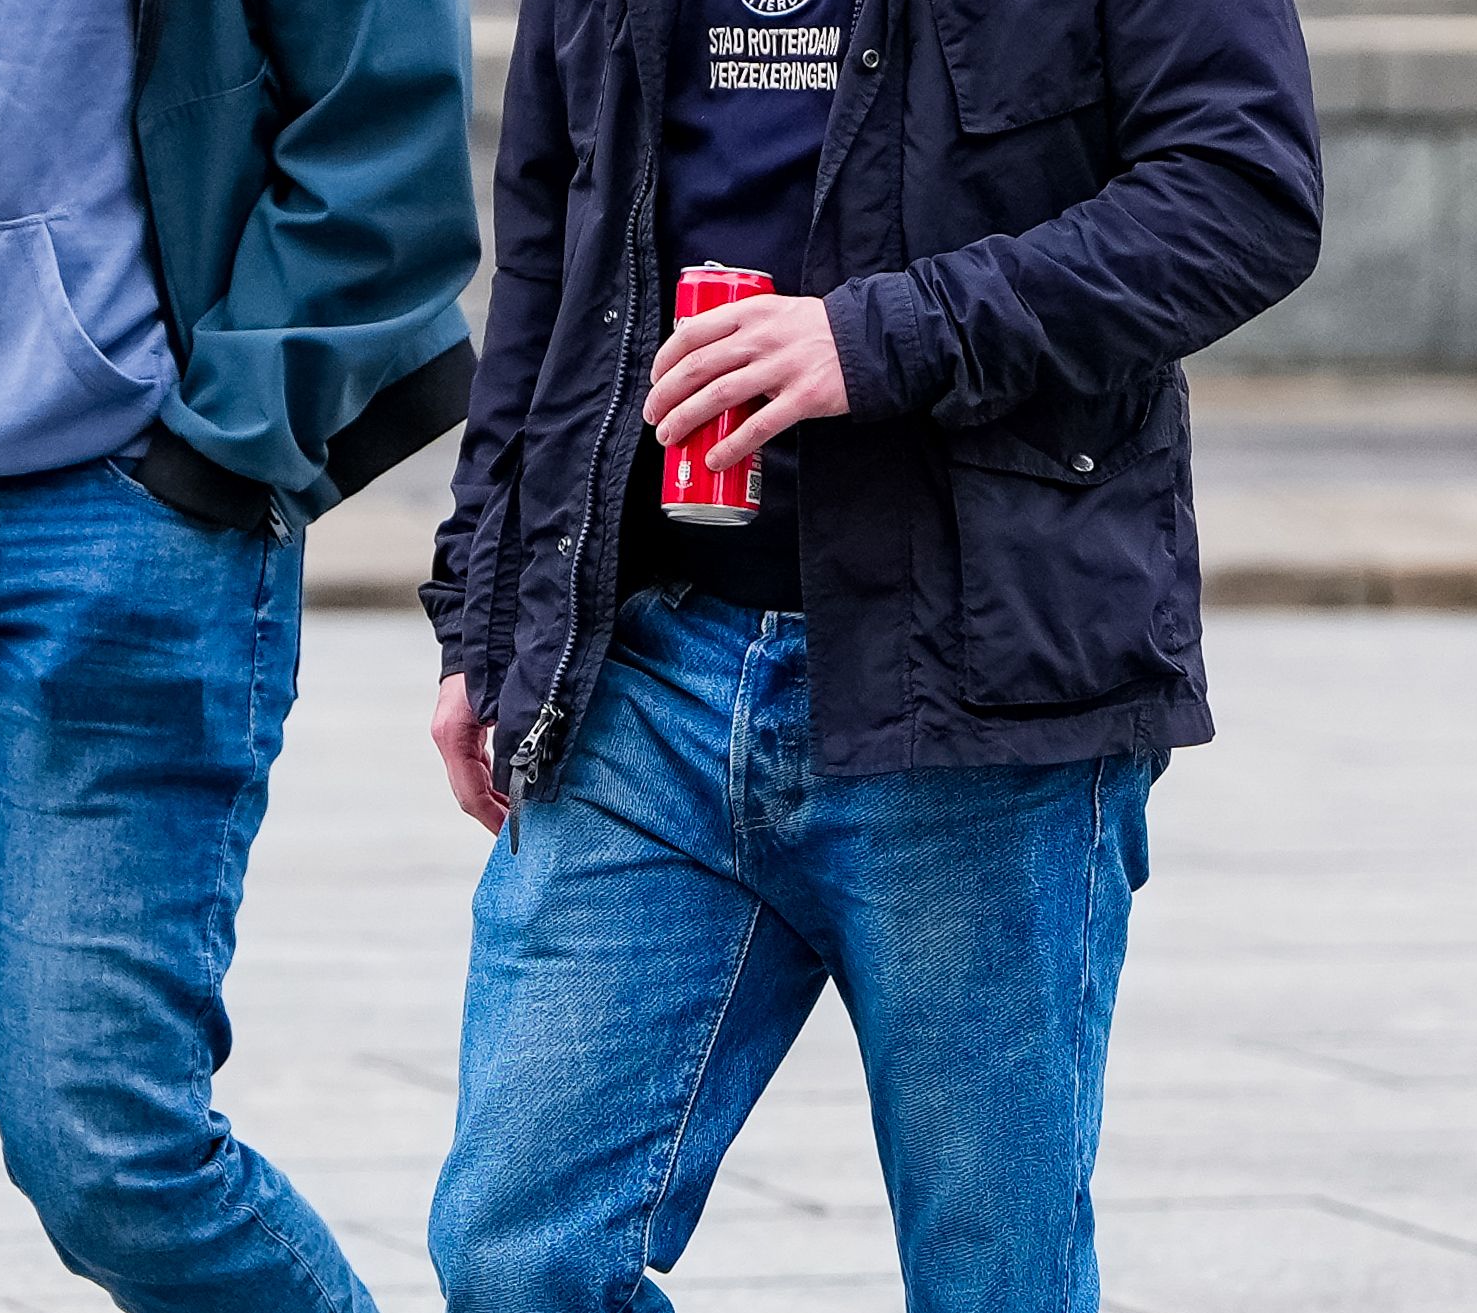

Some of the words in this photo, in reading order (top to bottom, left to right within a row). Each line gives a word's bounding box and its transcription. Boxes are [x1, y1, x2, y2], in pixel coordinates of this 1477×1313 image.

[708, 26, 745, 56] STAD
[748, 26, 841, 57] ROTTERDAM
[709, 61, 838, 91] VERZEKERINGEN
